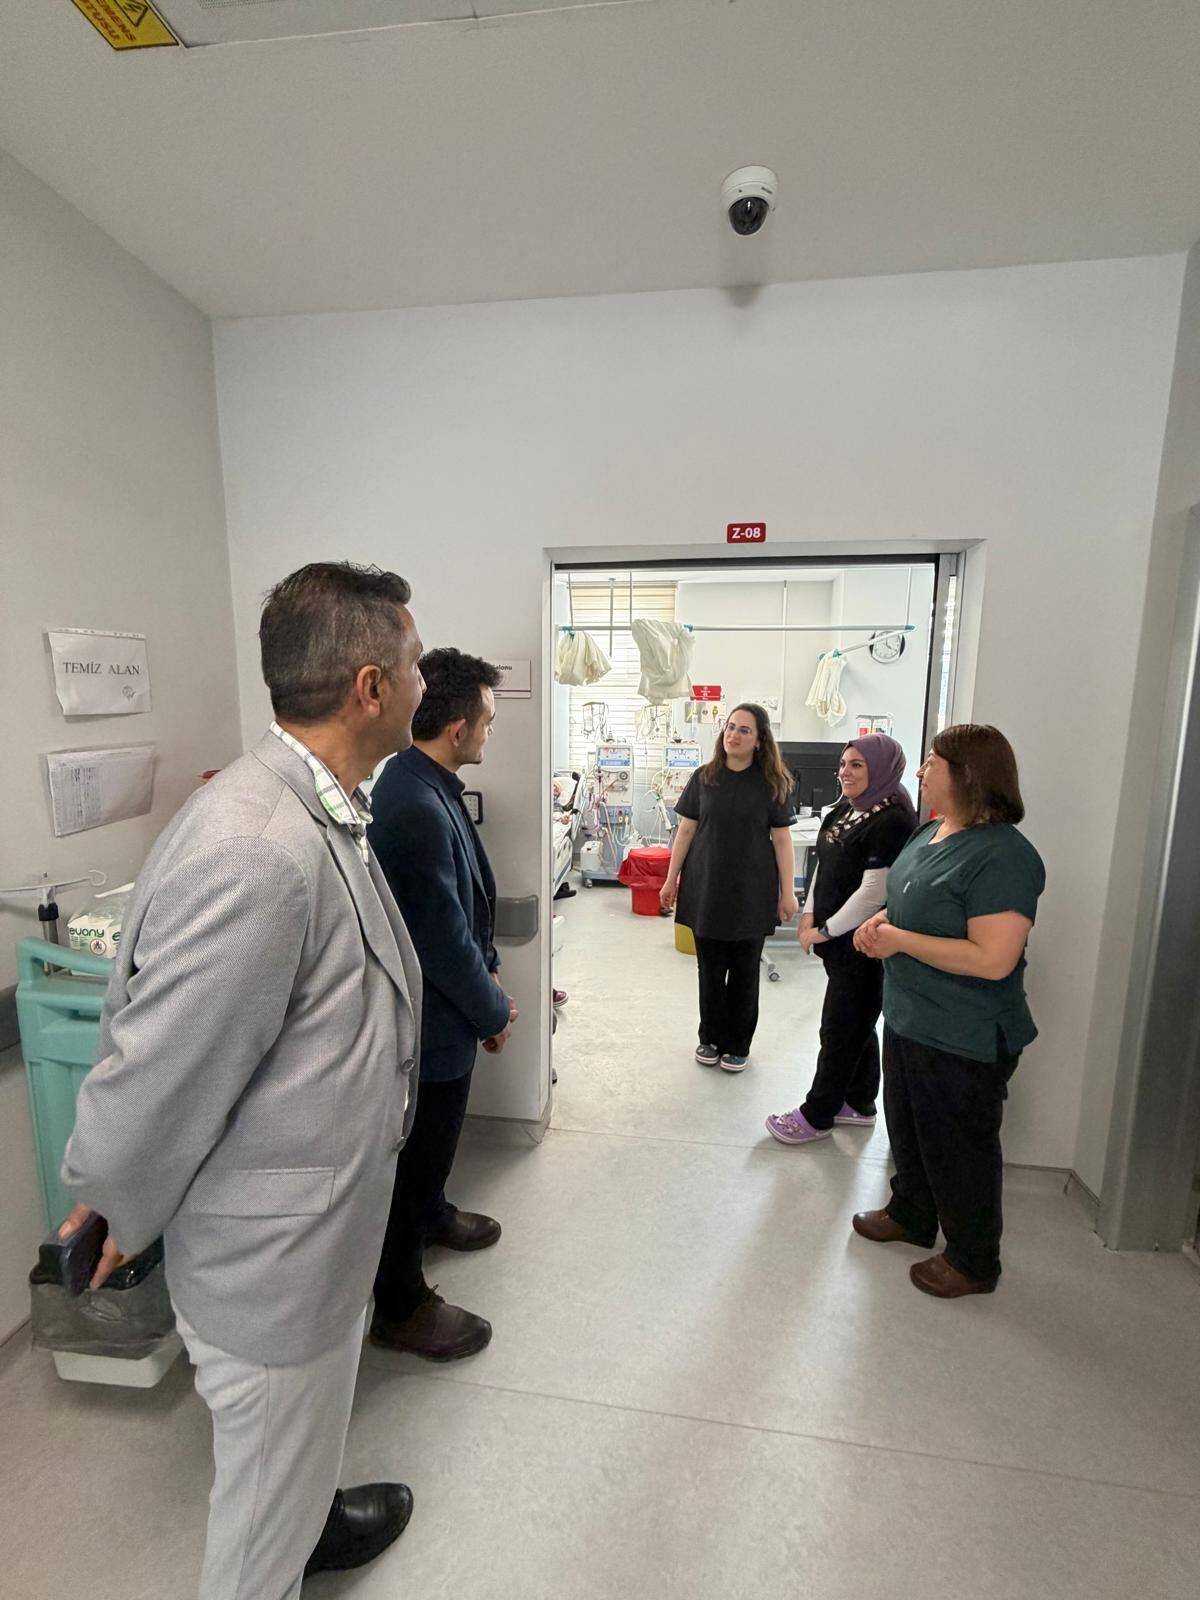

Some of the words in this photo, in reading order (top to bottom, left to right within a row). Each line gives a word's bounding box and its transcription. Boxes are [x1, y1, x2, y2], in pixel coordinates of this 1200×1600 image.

[731, 527, 761, 539] Z-08
[63, 661, 102, 674] TEMİZ
[108, 664, 140, 675] ALAN
